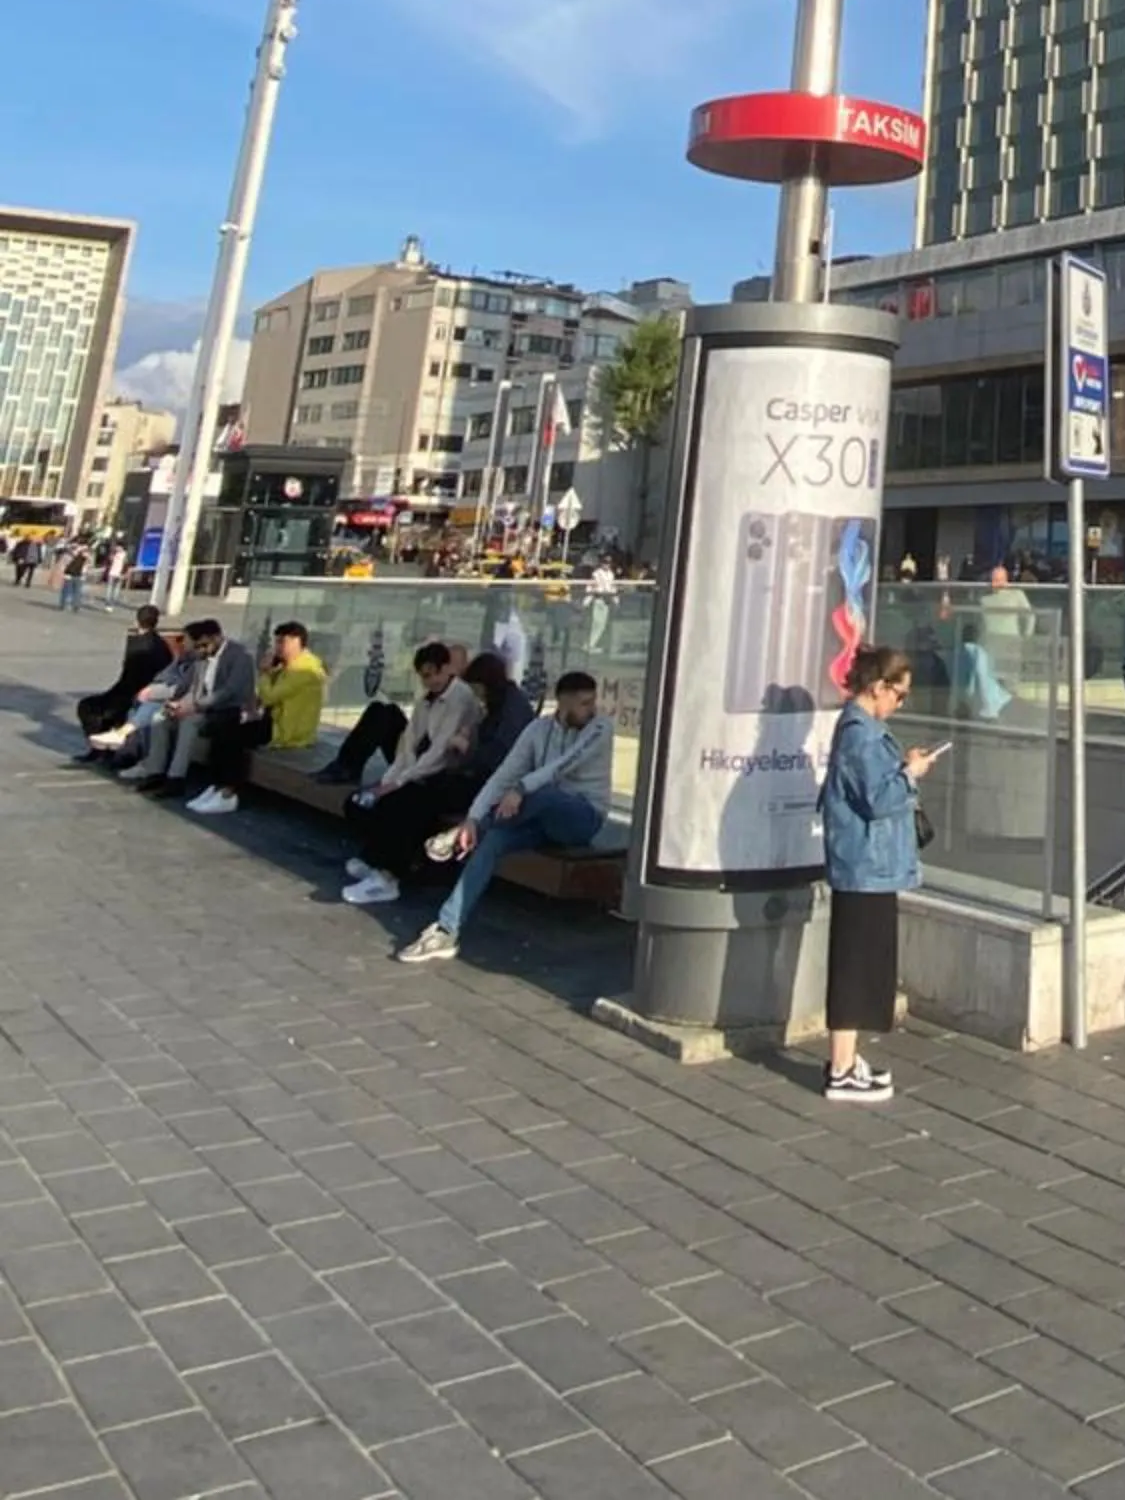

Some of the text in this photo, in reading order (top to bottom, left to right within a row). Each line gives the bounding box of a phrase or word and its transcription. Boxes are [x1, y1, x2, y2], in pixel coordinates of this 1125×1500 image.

[766, 397, 852, 429] Casper
[760, 433, 867, 488] X30
[701, 748, 813, 776] Hikayelerin
